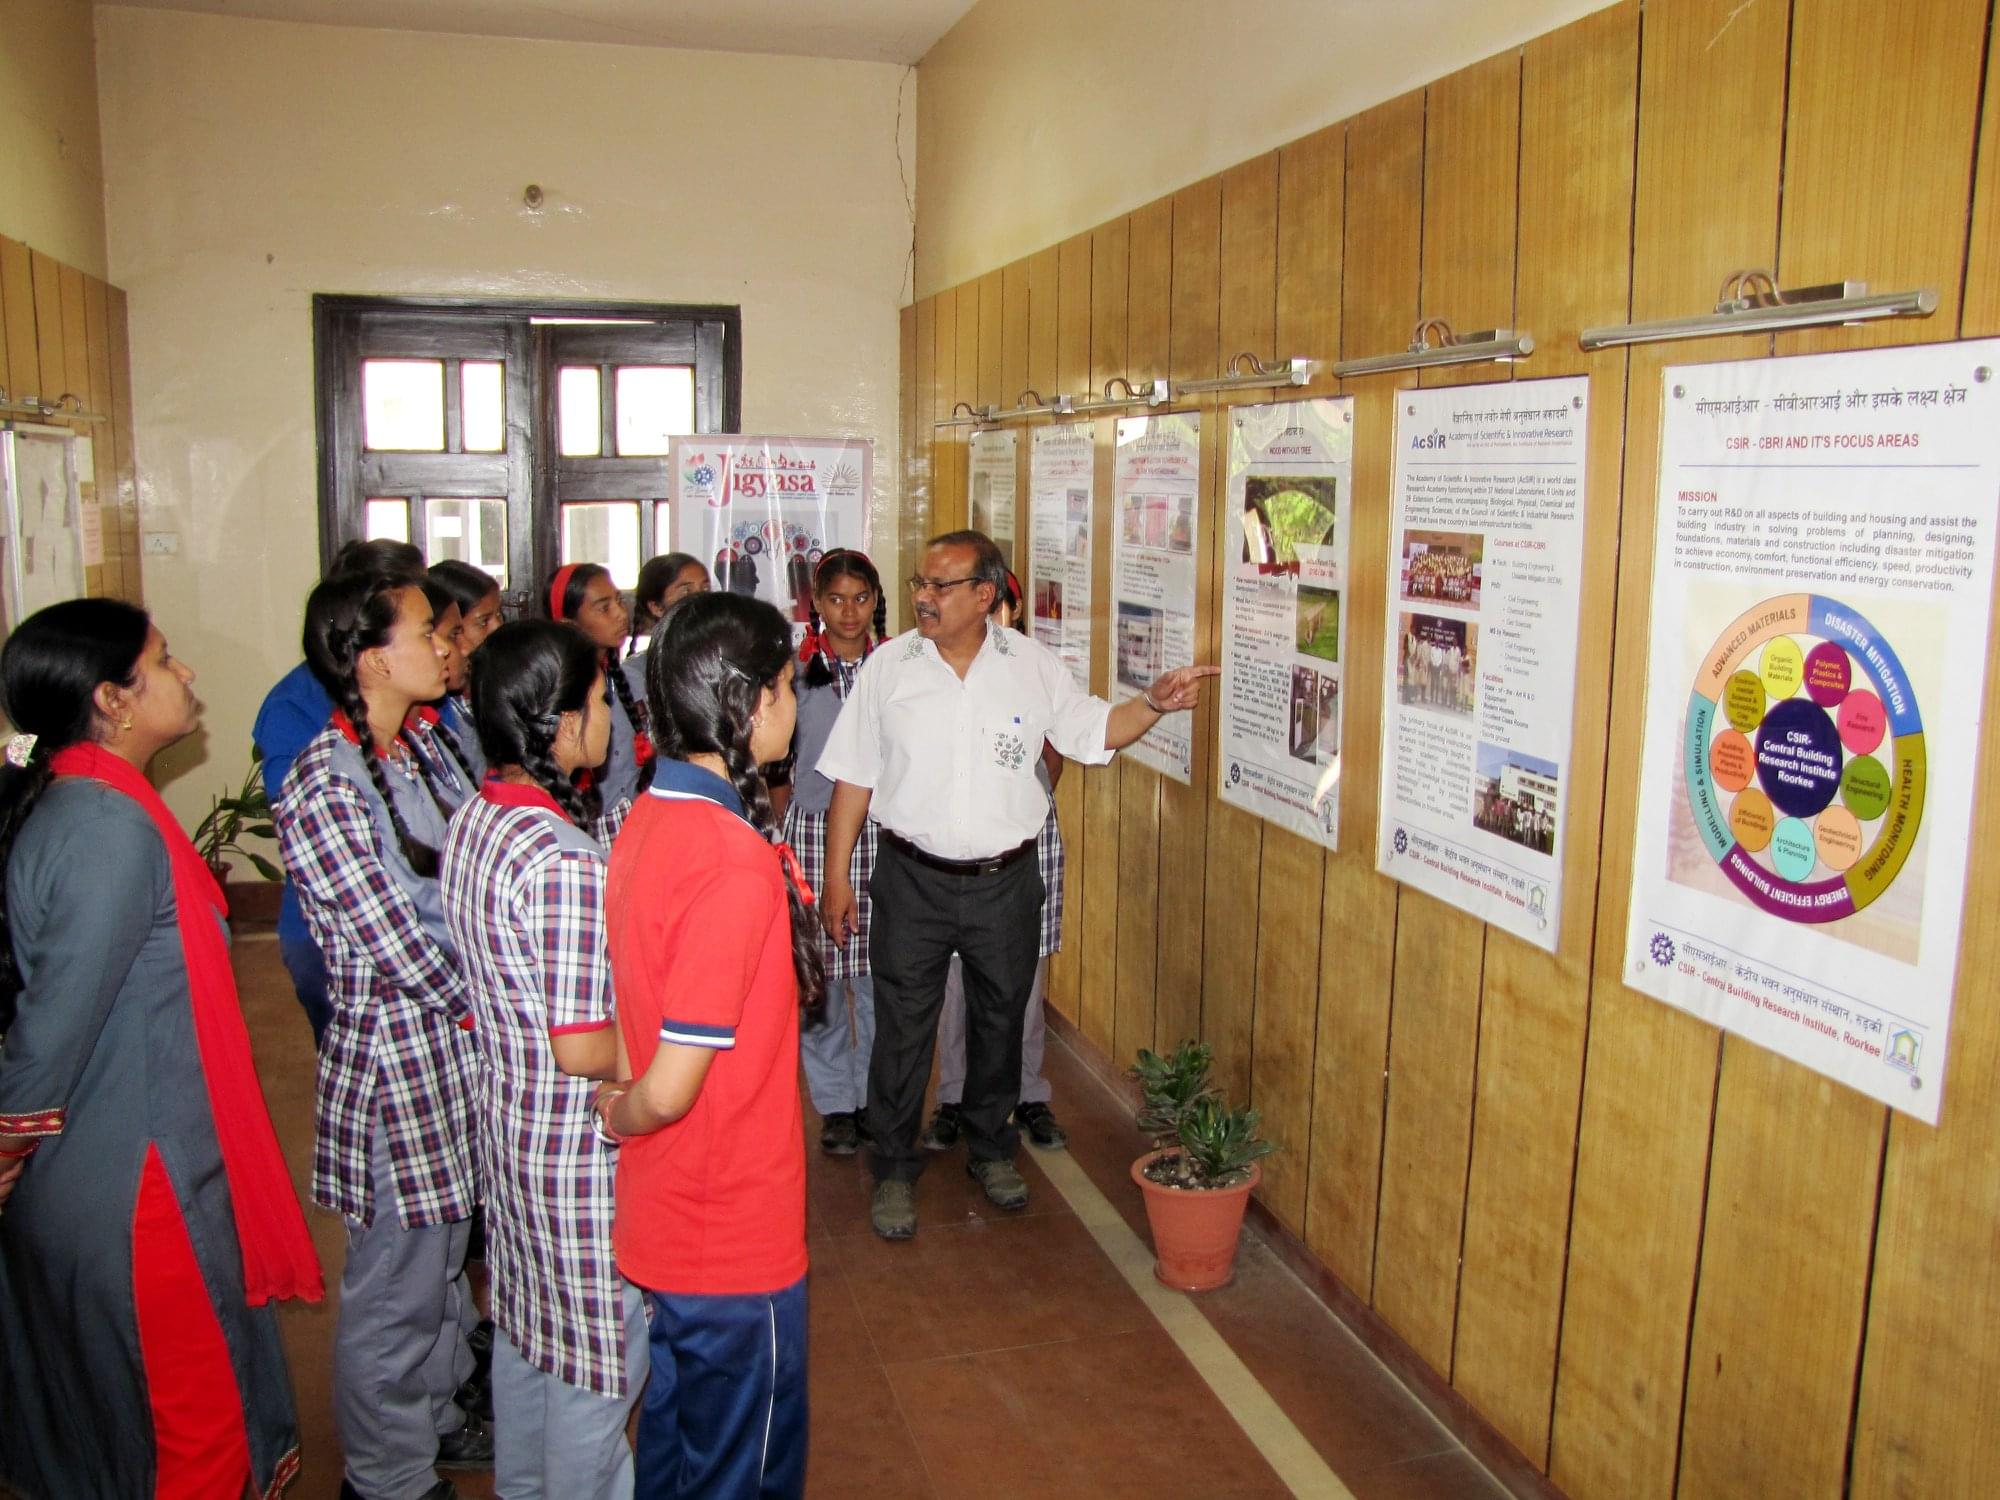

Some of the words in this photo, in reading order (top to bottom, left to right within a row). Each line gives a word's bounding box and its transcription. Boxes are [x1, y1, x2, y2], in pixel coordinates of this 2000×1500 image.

[1411, 427, 1446, 449] AcSIR
[1448, 432, 1472, 443] Academy
[1480, 430, 1505, 440] Scientific
[1513, 429, 1543, 439] Innovative
[1544, 427, 1573, 438] Research
[1726, 437, 1749, 450] CSIR
[1759, 436, 1783, 449] CBRI
[1785, 435, 1808, 449] AND
[1811, 435, 1831, 448] IT'S
[1834, 434, 1874, 448] FOCUS
[1877, 433, 1919, 447] AREAS
[708, 453, 816, 508] Jigyasa
[1678, 491, 1717, 502] MISSION
[1678, 506, 1686, 515] To
[1688, 508, 1708, 517] carry
[1710, 509, 1722, 517] out
[1725, 508, 1742, 518] R&D
[1744, 510, 1753, 518] on
[1755, 509, 1765, 518] all
[1767, 511, 1799, 521] aspects
[1802, 511, 1812, 520] of
[1813, 511, 1847, 524] building
[1850, 513, 1867, 523] and
[1869, 513, 1906, 527] housing
[1909, 515, 1927, 525] and
[1929, 516, 1958, 527] assist
[1961, 516, 1977, 527] the
[1677, 520, 1707, 531] building
[1714, 522, 1745, 533] industry
[1753, 524, 1760, 532] in
[1768, 524, 1798, 536] solving
[1807, 526, 1846, 537] problems
[1855, 528, 1864, 537] of
[1925, 531, 1975, 546] designing,
[1726, 537, 1760, 547] materials
[1765, 538, 1779, 547] and
[1783, 539, 1836, 551] construction
[1840, 543, 1880, 556] including
[1885, 545, 1921, 557] disaster
[1925, 547, 1974, 560] mitigation
[1675, 546, 1682, 555] to
[1685, 547, 1713, 556] achieve
[1754, 553, 1788, 563] comfort,
[1791, 554, 1832, 567] functional
[1882, 561, 1912, 573] speed,
[1915, 564, 1973, 579] productivity
[1674, 558, 1681, 567] in
[1683, 560, 1733, 573] construction,
[1735, 565, 1784, 577] environment
[1785, 567, 1837, 581] preservation
[1840, 573, 1856, 583] and
[1858, 575, 1889, 588] energy
[1891, 578, 1954, 592] conservation.
[1712, 631, 1747, 678] ADVANCED
[1747, 608, 1797, 635] MATERIALS
[1769, 663, 1792, 674] Building
[1813, 668, 1836, 678] Plastics
[1825, 612, 1868, 649] DISASTER
[1866, 644, 1905, 715] MITIGATION
[1809, 677, 1844, 689] Composites
[1695, 709, 1706, 775] SIMULATION
[1787, 731, 1812, 744] CSIR-
[1764, 740, 1795, 755] Central
[1797, 747, 1833, 766] Building
[1759, 752, 1798, 770] Research
[1800, 762, 1836, 779] Institute
[1778, 770, 1814, 788] Roorkee
[1899, 759, 1913, 809] HEALTH
[1698, 791, 1728, 848] MODELLING
[1783, 847, 1807, 861] Planning
[1819, 834, 1855, 851] Engineering
[1864, 811, 1907, 881] MONITORING
[1731, 853, 1770, 895] BUILDINGS
[1770, 887, 1812, 906] EFFICIENT
[1814, 886, 1848, 906] ENERGY
[1677, 961, 1696, 977] CSIR
[1702, 971, 1726, 991] Central
[1727, 983, 1760, 1008] Building
[1763, 996, 1800, 1022] Research
[1802, 1014, 1839, 1040] Institute,
[1843, 1031, 1881, 1057] Roorkee
